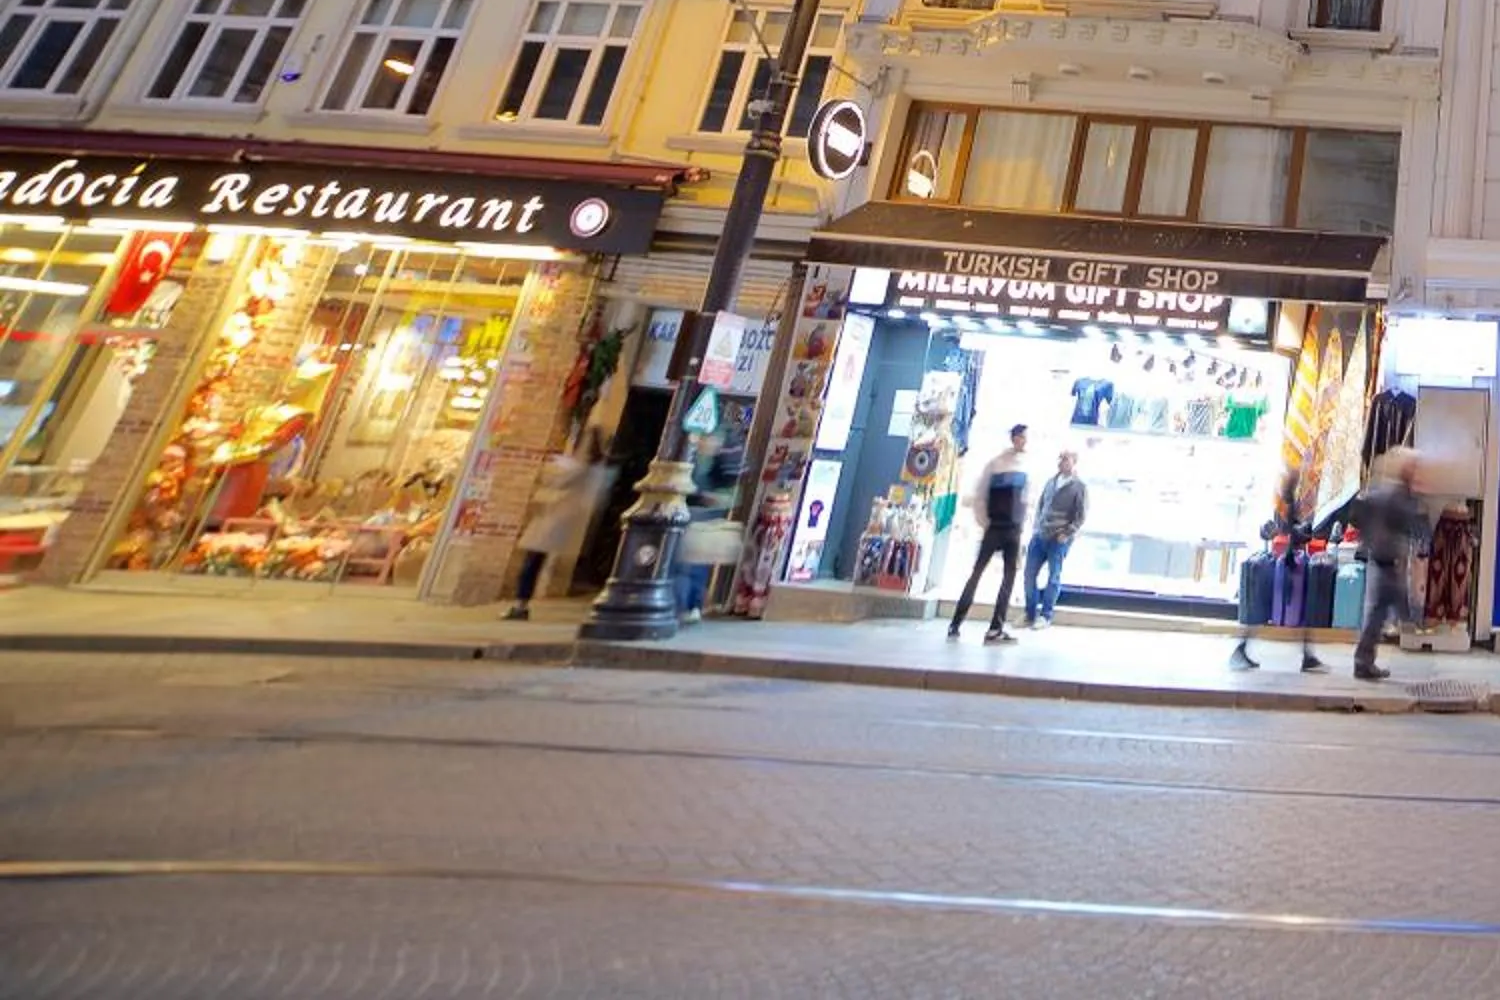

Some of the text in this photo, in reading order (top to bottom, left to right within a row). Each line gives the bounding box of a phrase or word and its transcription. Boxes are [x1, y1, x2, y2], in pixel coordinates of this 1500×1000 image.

[201, 173, 544, 233] Restaurant
[897, 270, 1055, 300] MILENYUM
[1065, 284, 1127, 307] GIFT
[1137, 290, 1223, 313] SHOP
[943, 251, 1219, 291] TURKISH GIFT SHOP
